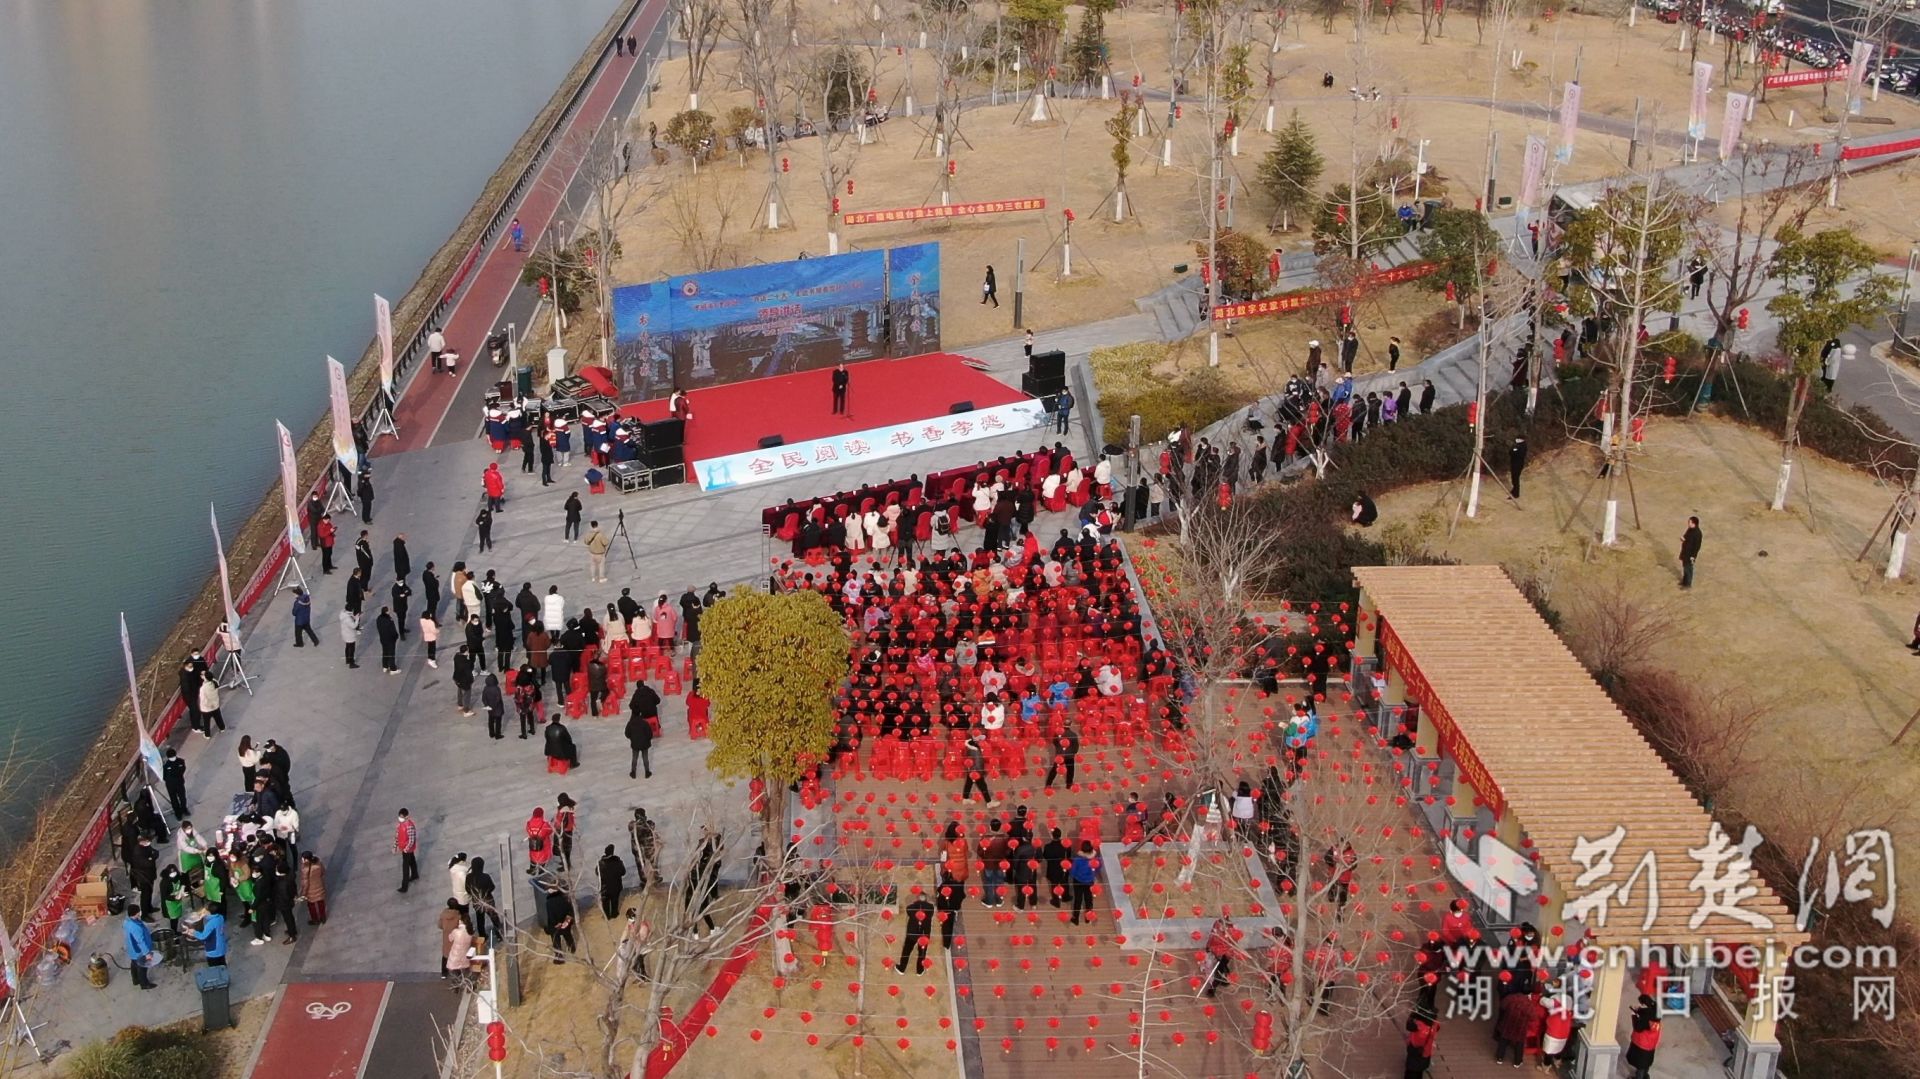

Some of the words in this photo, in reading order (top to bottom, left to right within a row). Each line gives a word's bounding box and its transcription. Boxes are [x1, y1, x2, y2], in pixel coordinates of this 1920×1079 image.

[748, 438, 871, 475] 全民阅读
[890, 414, 1005, 448] 书香孝感
